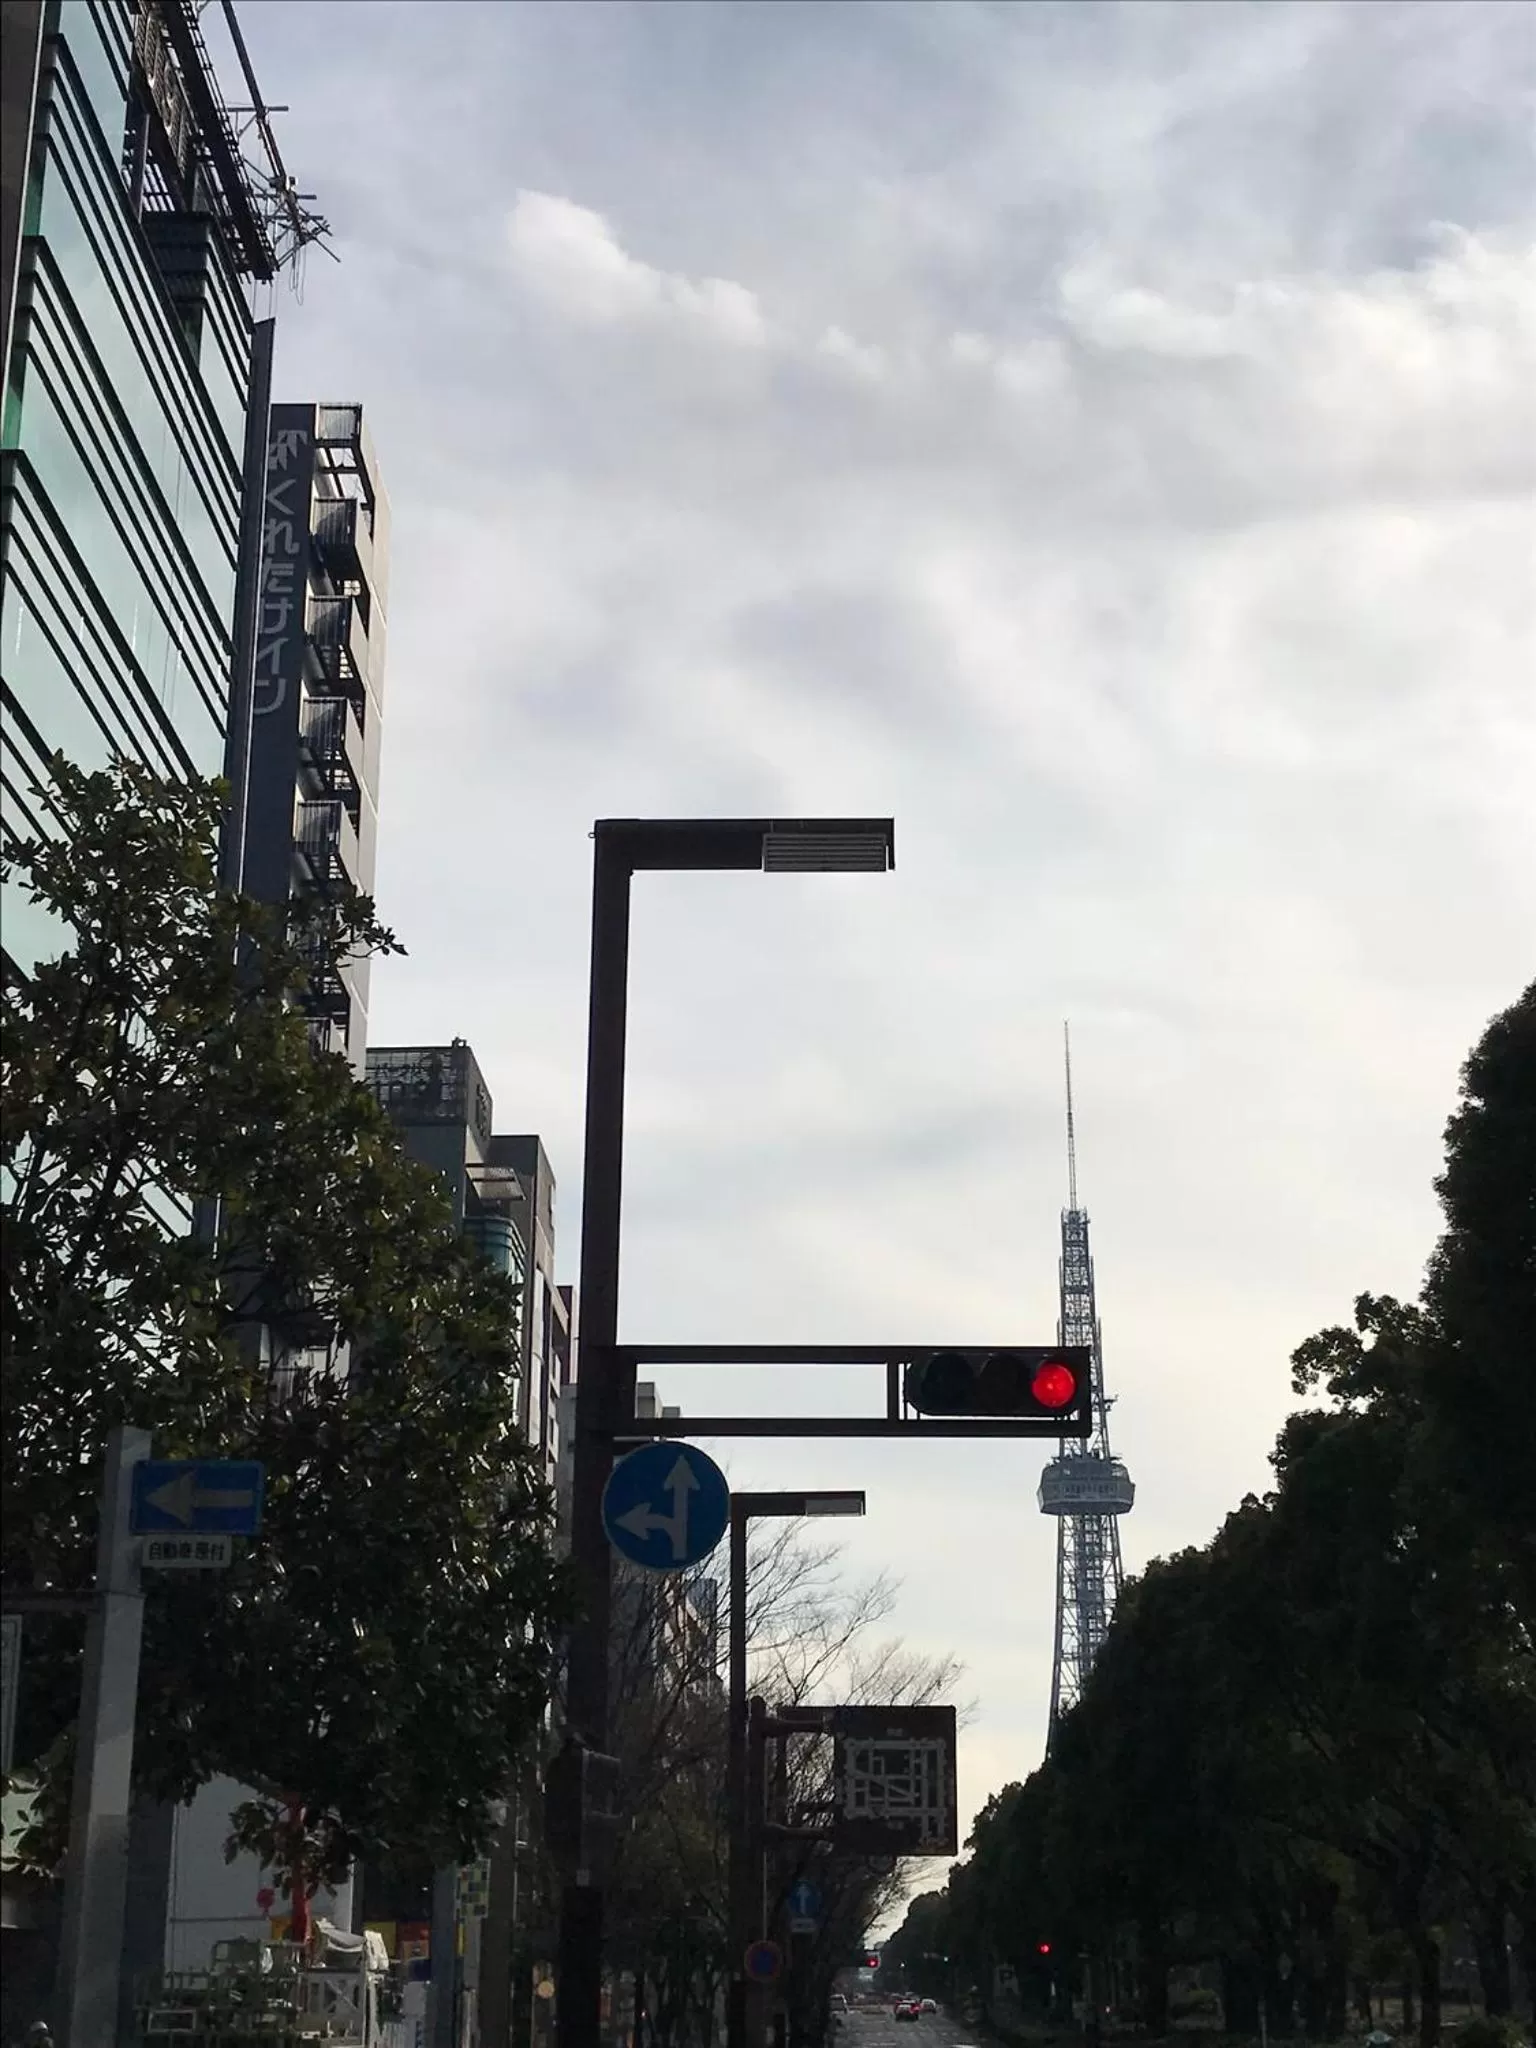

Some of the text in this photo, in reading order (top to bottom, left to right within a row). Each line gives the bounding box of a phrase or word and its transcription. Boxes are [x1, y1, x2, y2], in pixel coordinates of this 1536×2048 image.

[254, 478, 300, 714] くれたけイン
